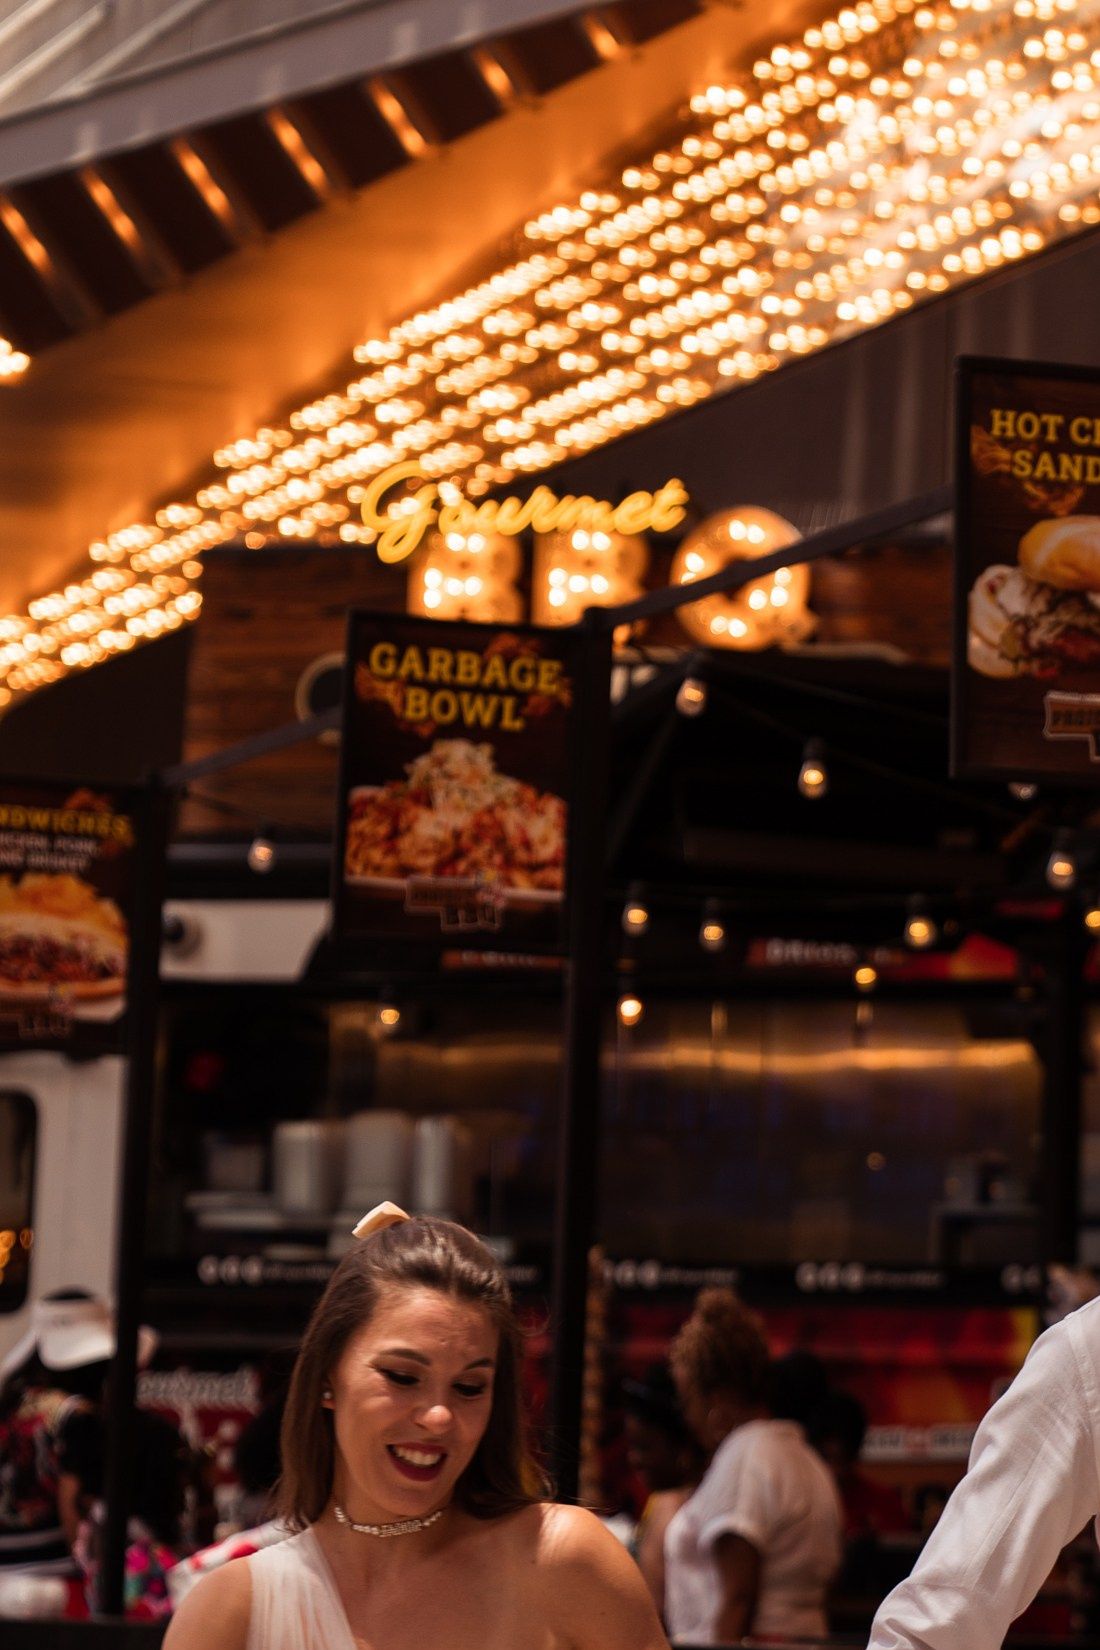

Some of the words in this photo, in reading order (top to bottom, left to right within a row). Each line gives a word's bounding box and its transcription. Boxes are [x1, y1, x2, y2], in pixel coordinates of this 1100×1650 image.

[990, 409, 1064, 442] HOT
[361, 460, 690, 563] Gourmet
[368, 641, 563, 695] GARBAGE
[402, 686, 526, 731] BOWL
